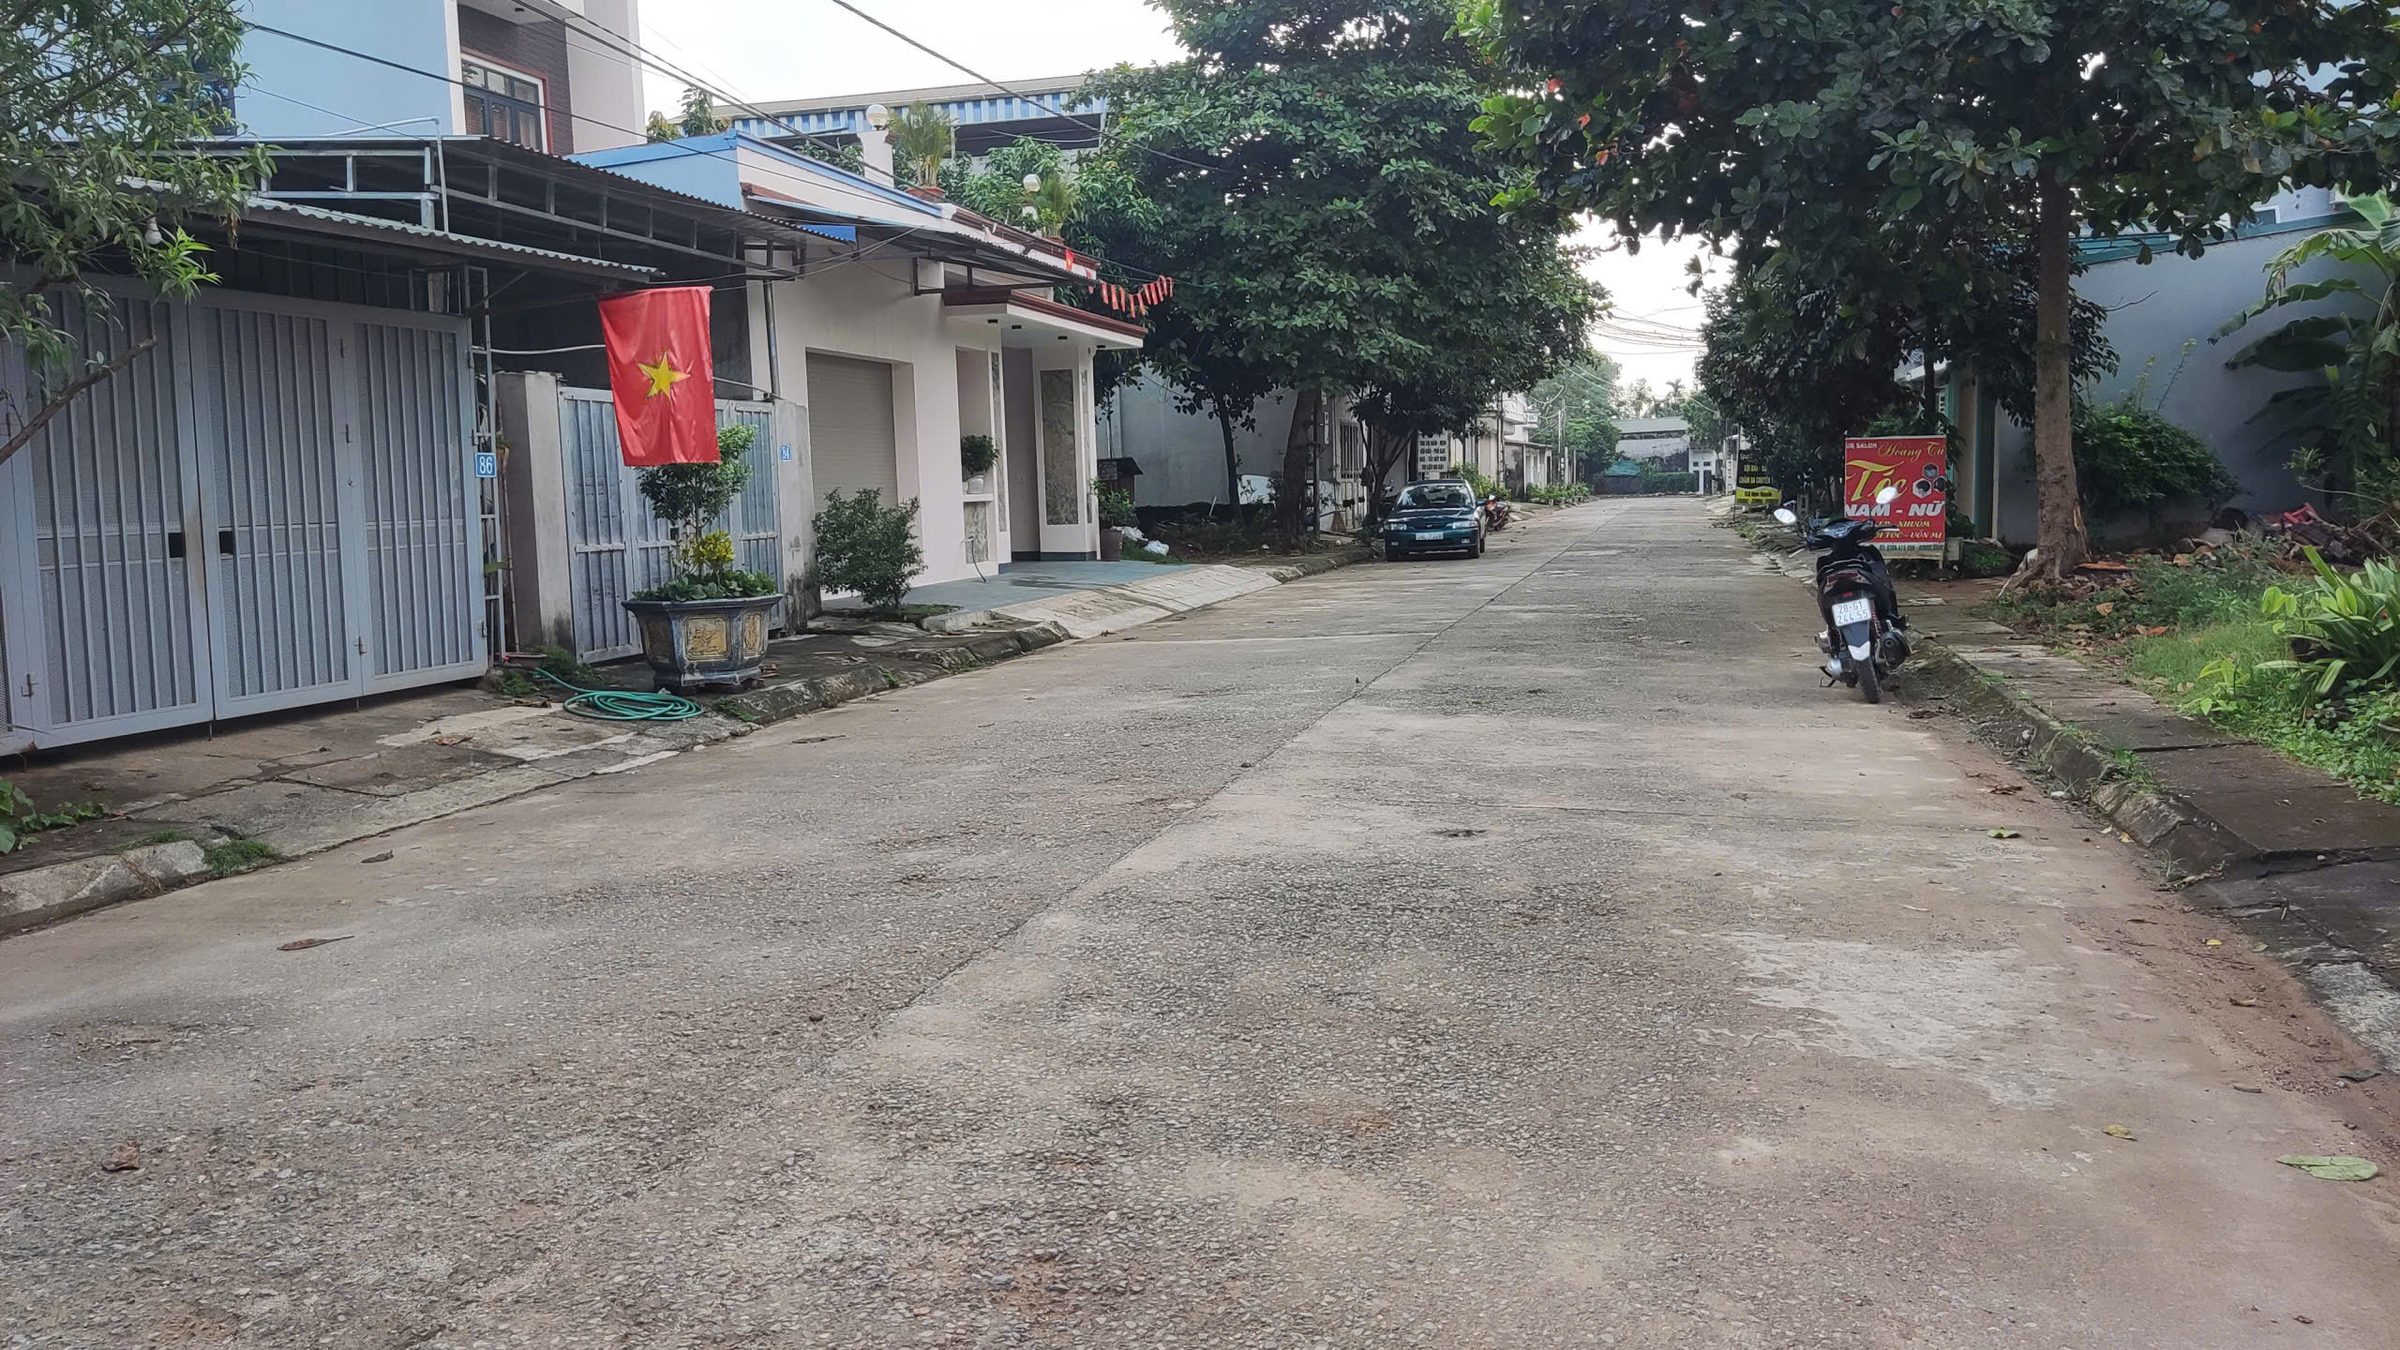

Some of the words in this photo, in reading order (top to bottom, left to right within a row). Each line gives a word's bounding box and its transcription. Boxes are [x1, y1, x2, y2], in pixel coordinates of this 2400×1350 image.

[479, 456, 493, 474] 86
[1846, 459, 1908, 502] Tóc
[1845, 503, 1890, 517] NAM
[1908, 500, 1945, 517] NỮ
